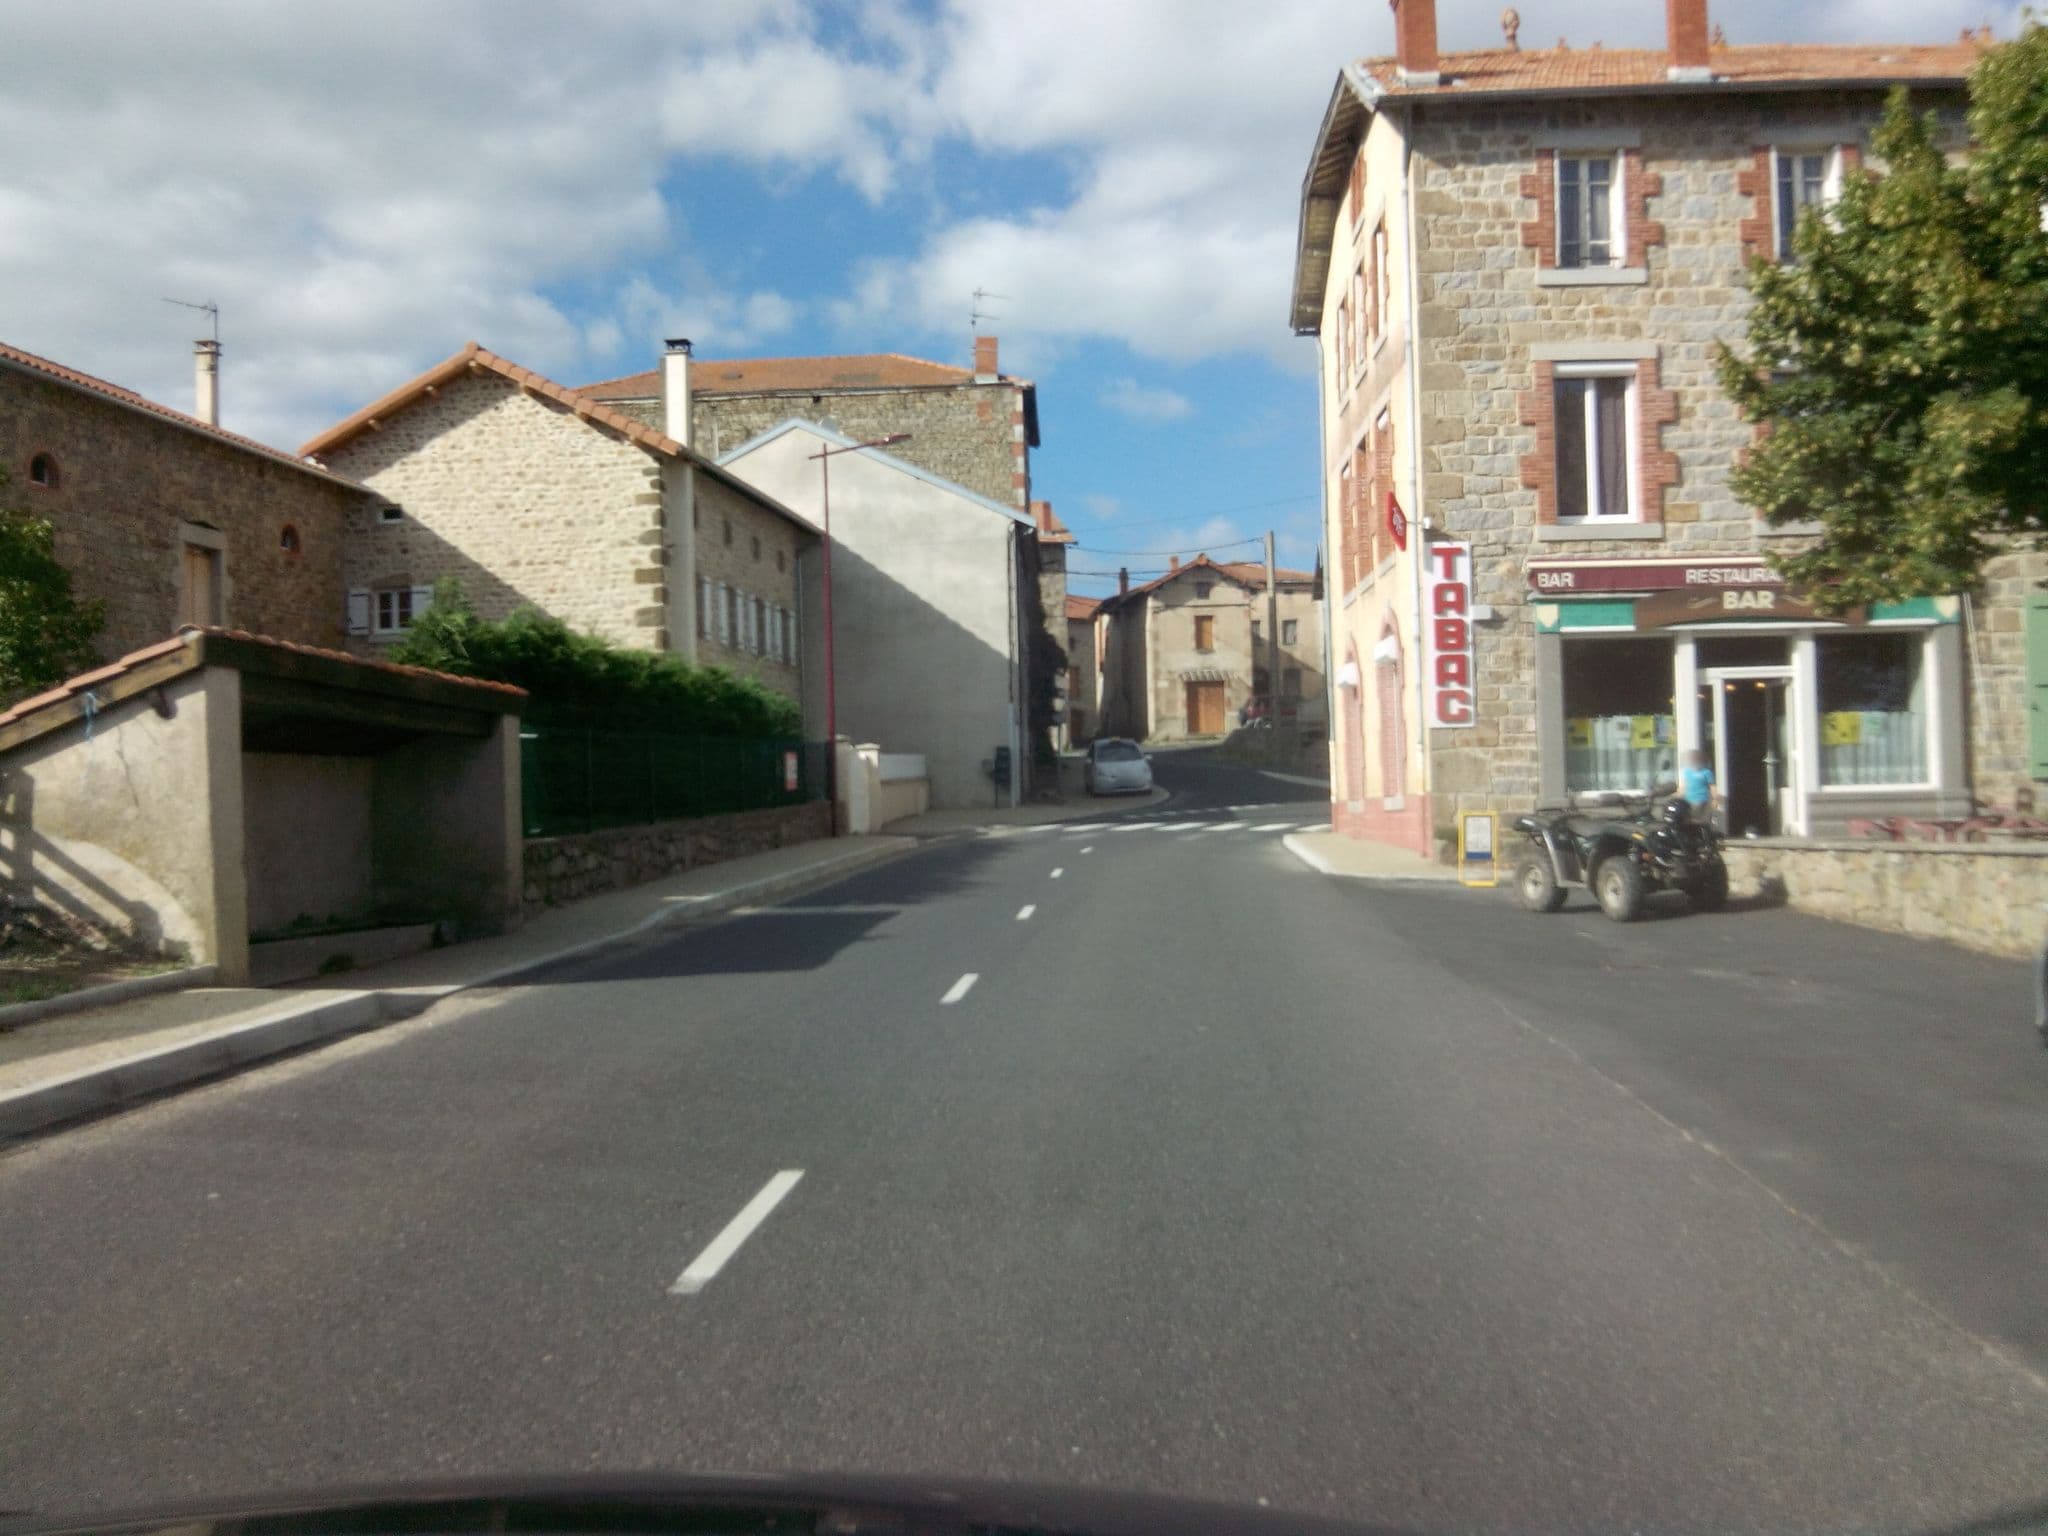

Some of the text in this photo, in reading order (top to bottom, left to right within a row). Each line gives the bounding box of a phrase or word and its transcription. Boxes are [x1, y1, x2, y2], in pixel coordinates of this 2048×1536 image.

[1537, 567, 1783, 588] BAR RESTAURA
[1723, 590, 1775, 610] BAR
[1431, 546, 1471, 724] TABAC
